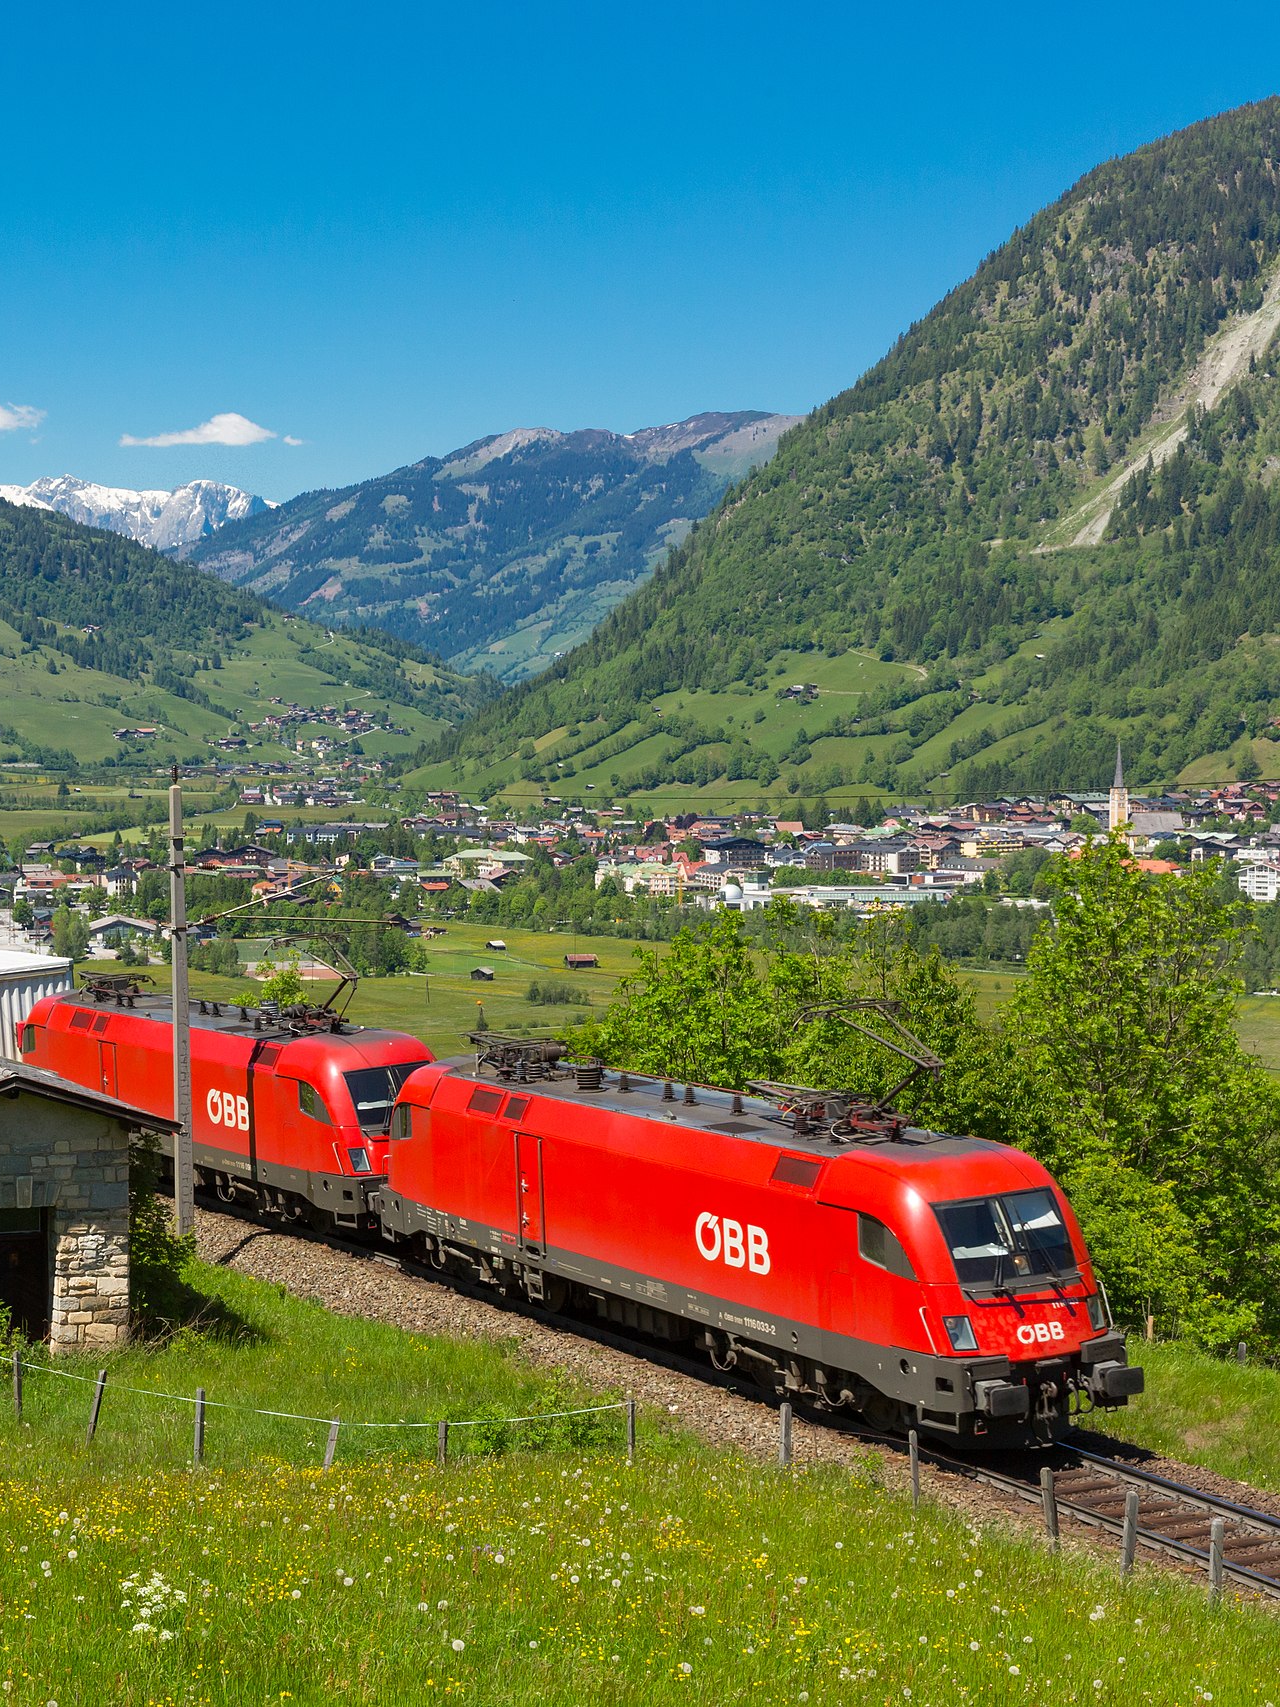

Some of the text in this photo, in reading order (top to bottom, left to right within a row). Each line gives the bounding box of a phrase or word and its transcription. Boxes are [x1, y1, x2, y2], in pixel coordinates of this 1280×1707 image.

[206, 1088, 250, 1131] ÖBB
[695, 1211, 770, 1275] ÖBB
[1017, 1321, 1065, 1344] ÖBB
